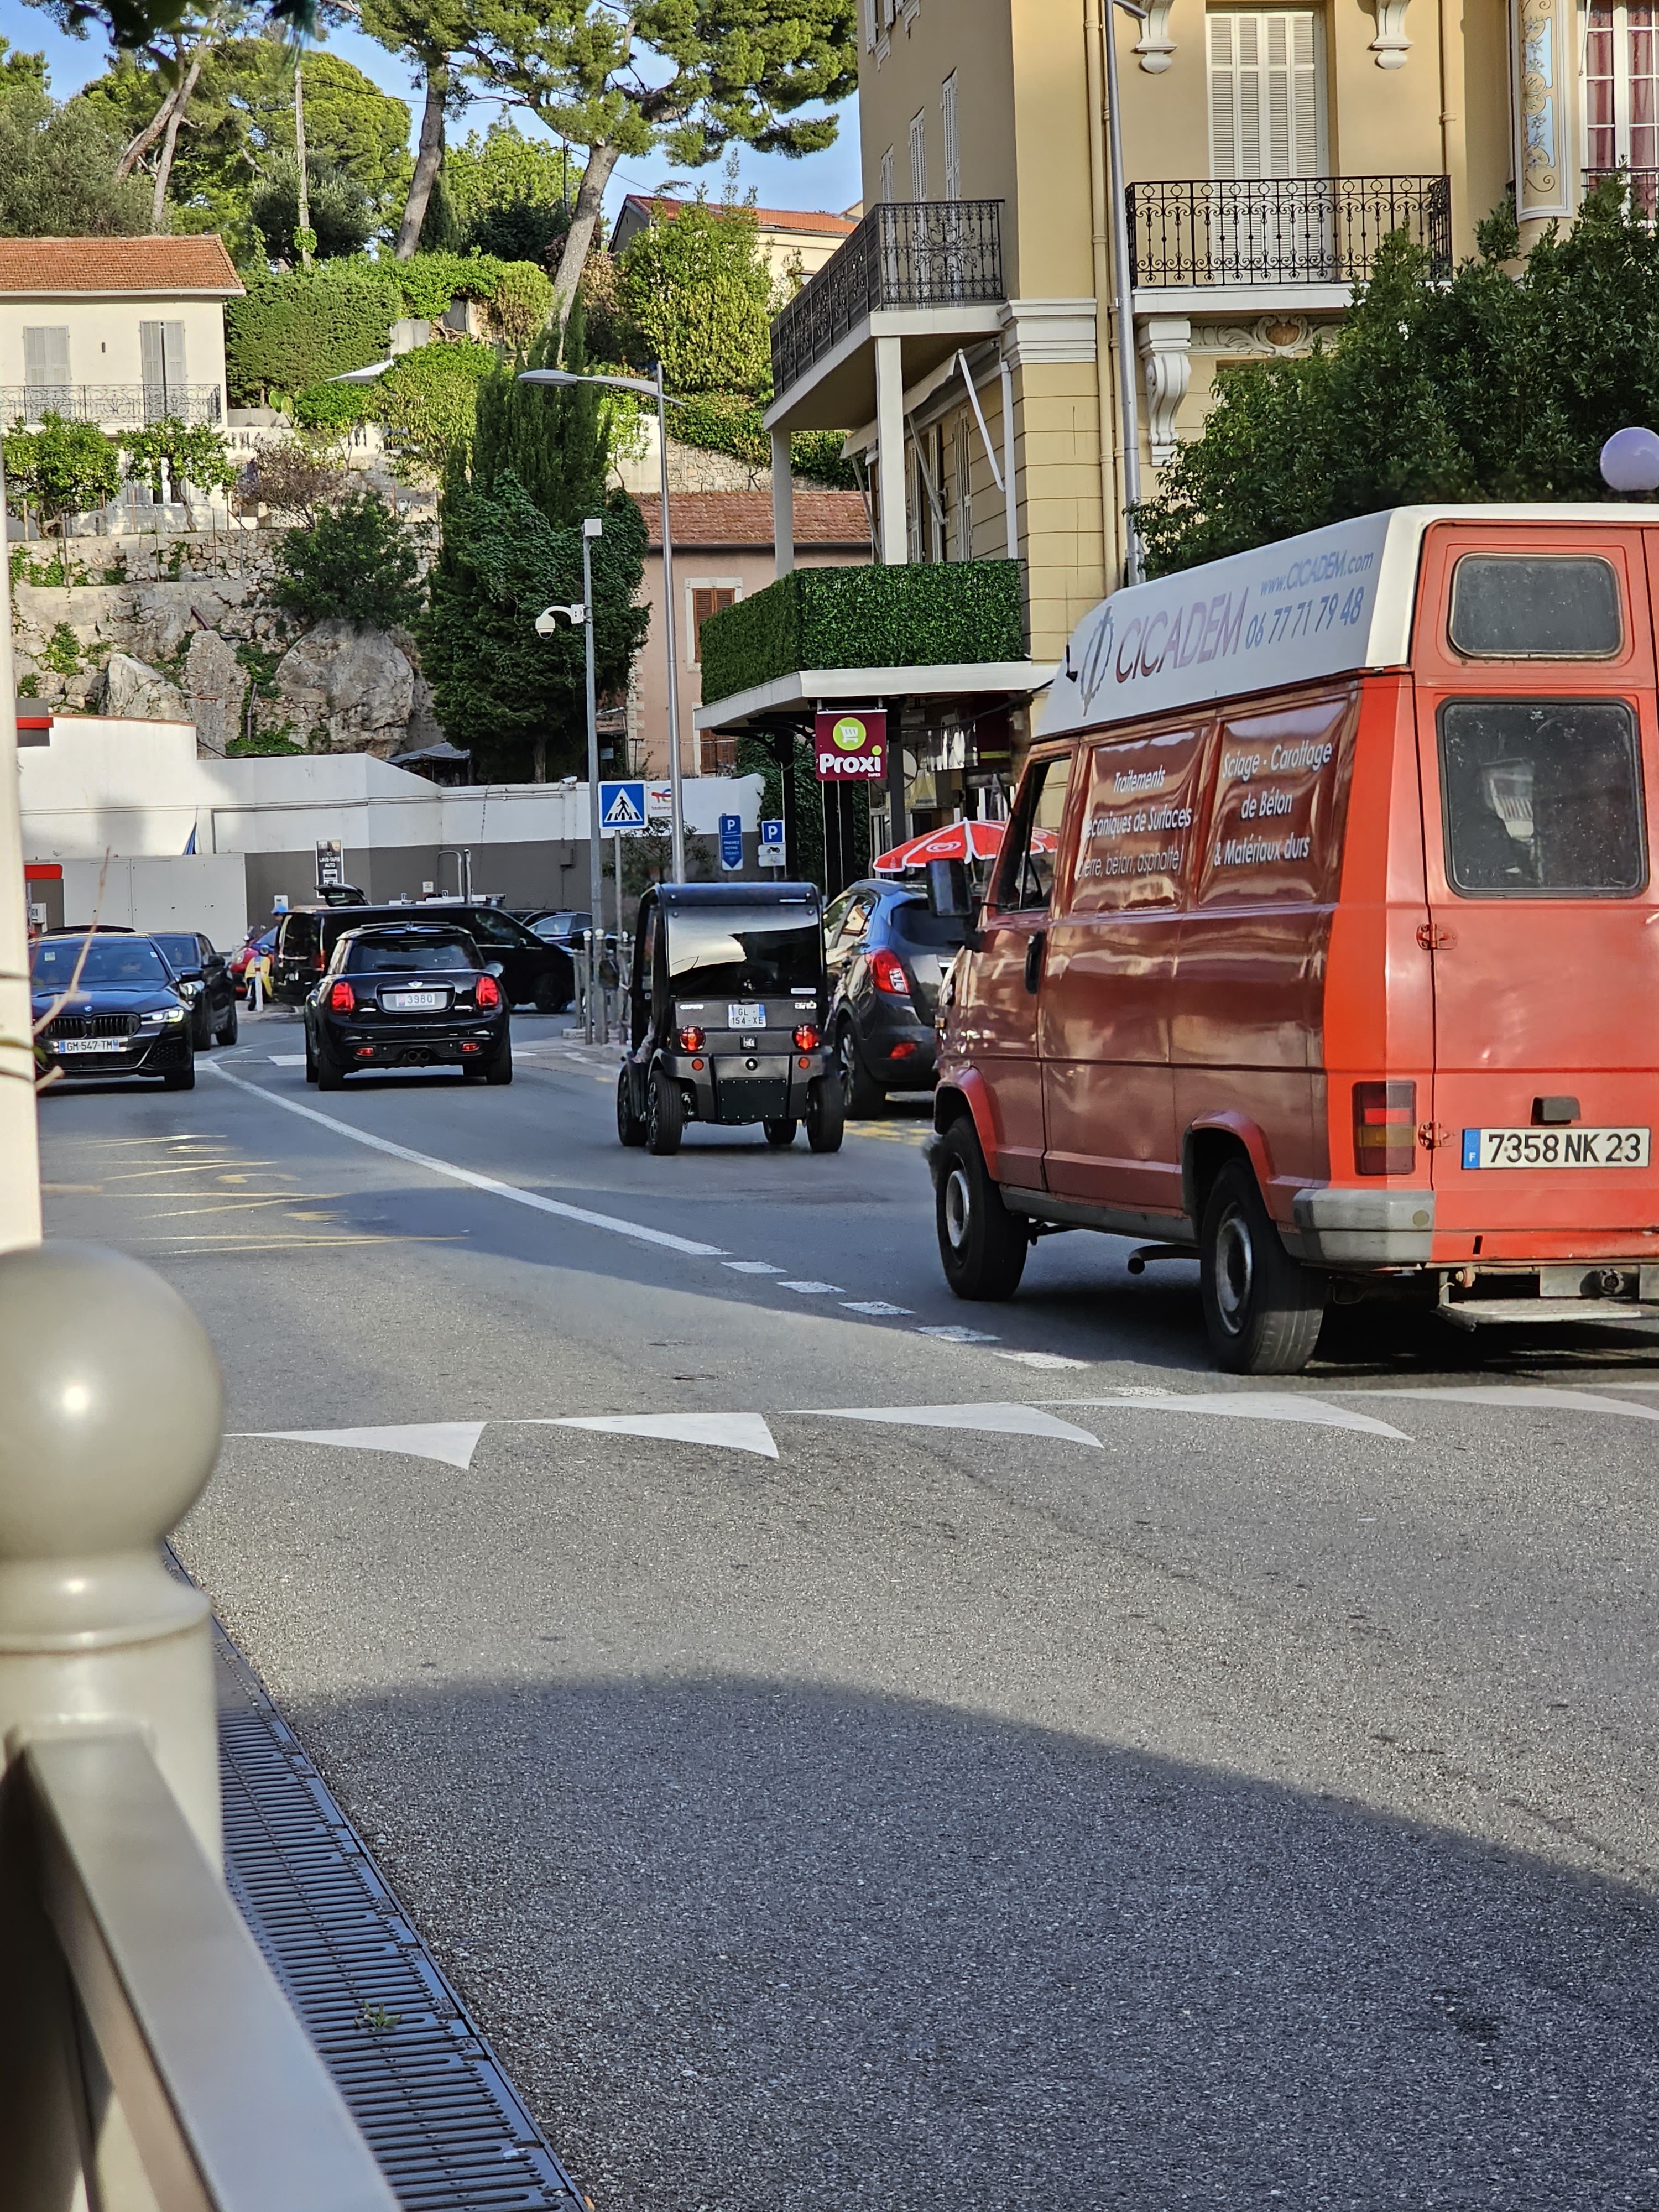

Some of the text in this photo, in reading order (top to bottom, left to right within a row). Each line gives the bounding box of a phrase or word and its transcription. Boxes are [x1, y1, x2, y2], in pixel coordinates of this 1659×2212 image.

[1245, 586, 1364, 650] 06 77 71 79 48
[1115, 586, 1249, 684] CICADEM
[820, 745, 883, 774] Proxi
[1222, 750, 1260, 781] Sciage
[1271, 740, 1332, 771] Carottage
[1113, 764, 1166, 792] Traitements
[1241, 786, 1292, 819] de Béton
[727, 819, 735, 831] P
[768, 825, 778, 840] P
[1082, 803, 1192, 839] écaniques de Surfaces
[1214, 831, 1310, 866] & Matériaux durs
[66, 1040, 113, 1051] GM-547-TM
[1469, 1152, 1476, 1162] F
[1489, 1133, 1641, 1163] 7358 NK 23
